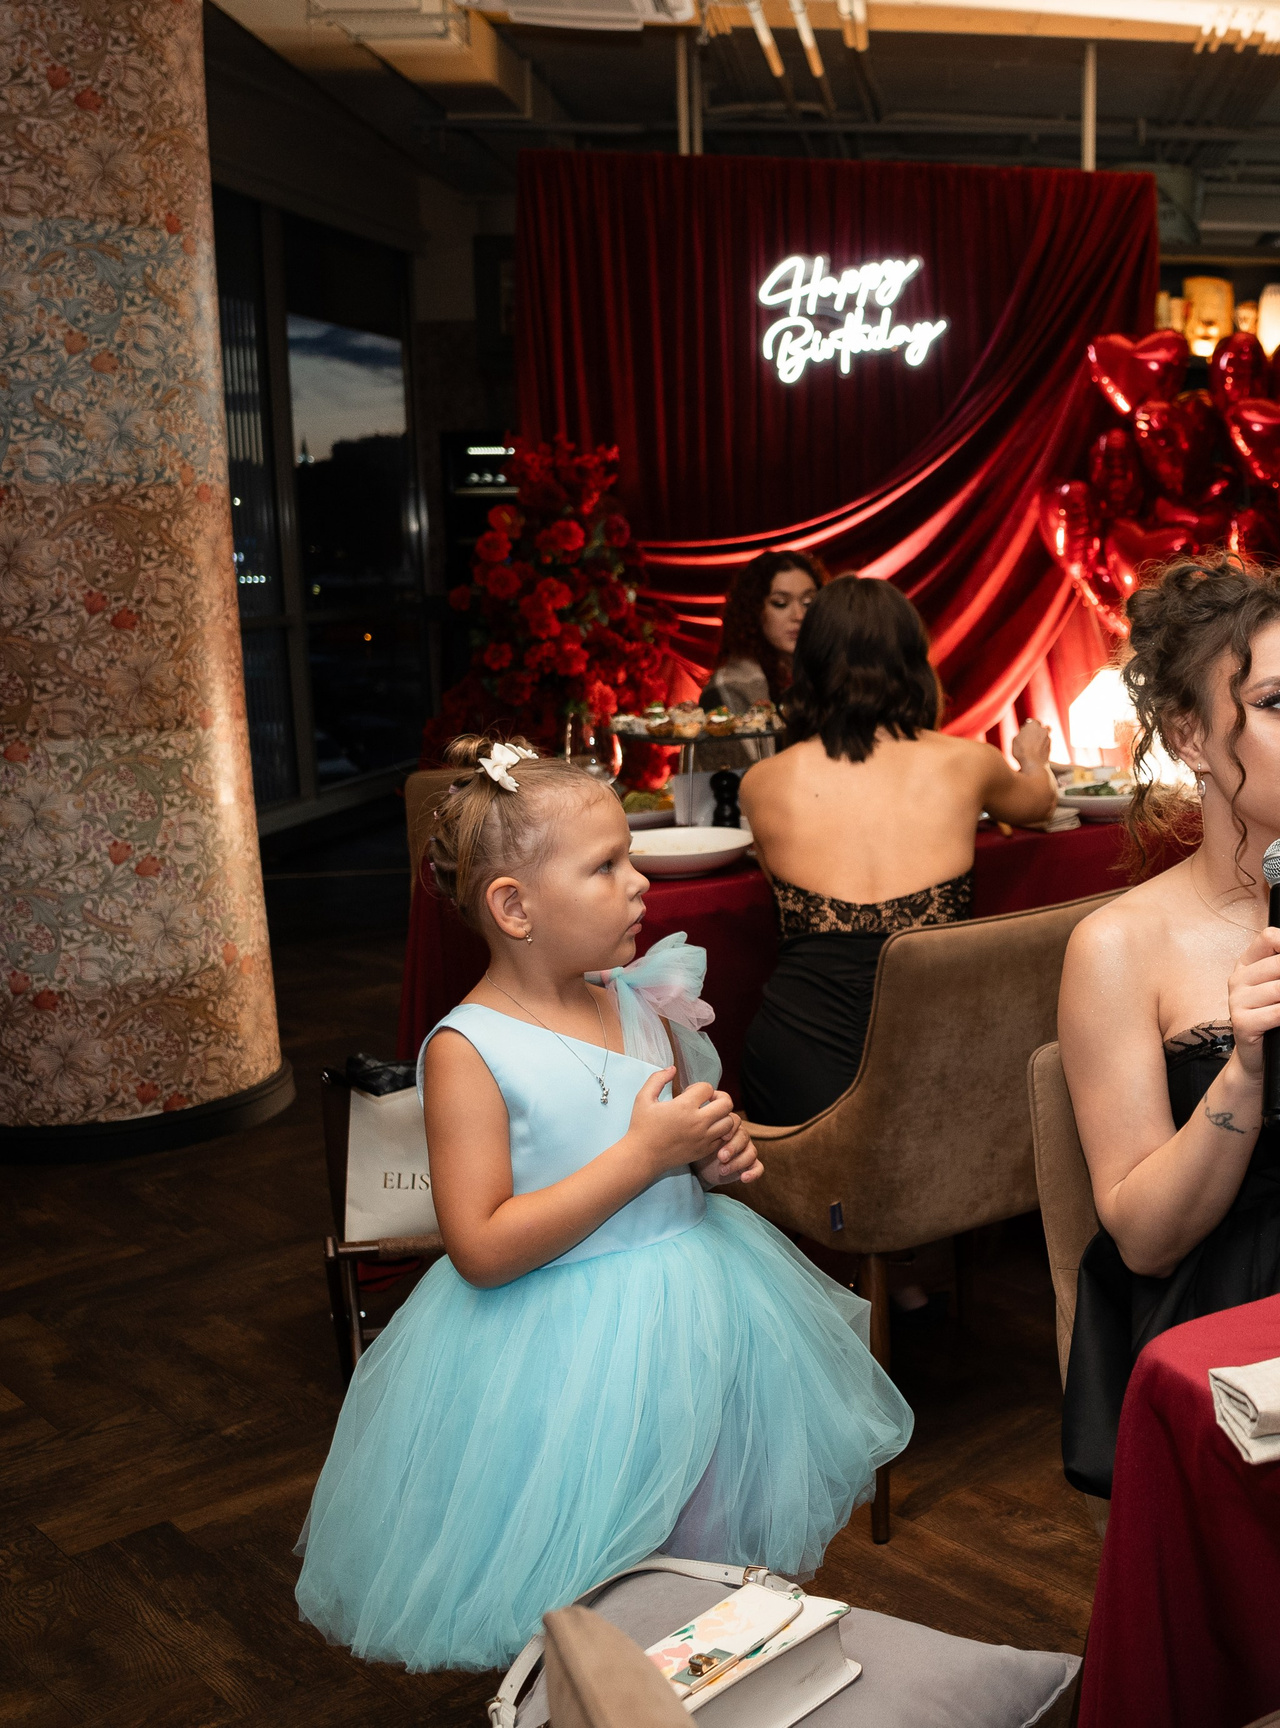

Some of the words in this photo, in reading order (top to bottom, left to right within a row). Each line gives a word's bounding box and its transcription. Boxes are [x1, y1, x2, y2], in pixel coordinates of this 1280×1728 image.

[758, 255, 920, 317] Happy
[762, 306, 947, 384] Birthday
[383, 1172, 430, 1191] ELIS
